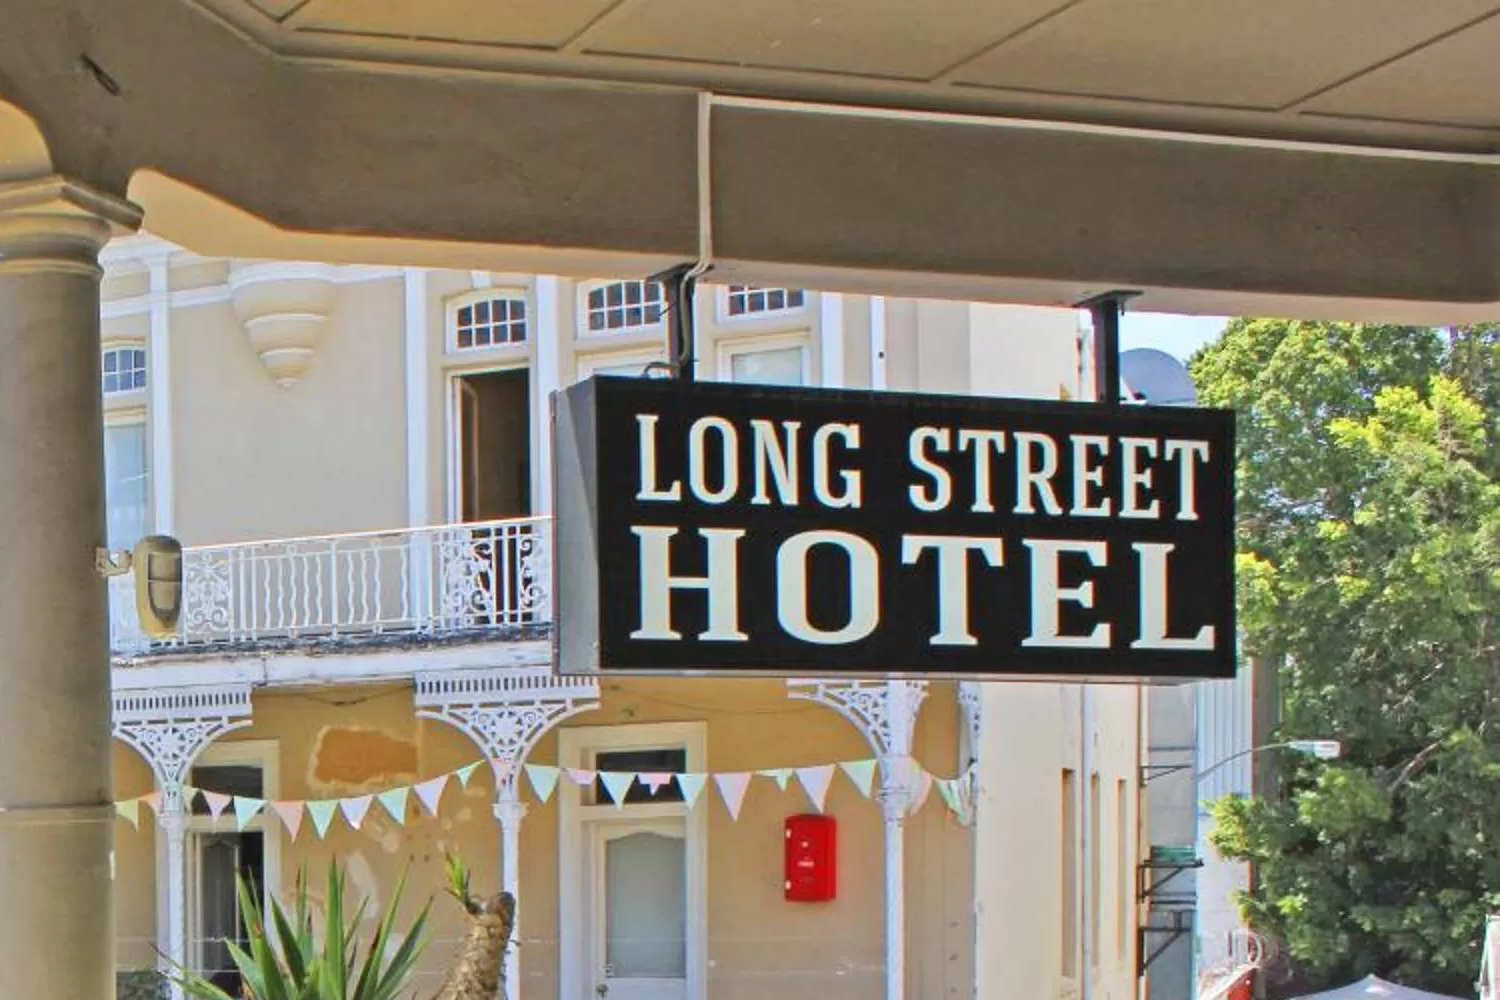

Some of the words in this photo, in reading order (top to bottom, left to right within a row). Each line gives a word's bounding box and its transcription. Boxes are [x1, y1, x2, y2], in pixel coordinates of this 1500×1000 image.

[635, 414, 862, 509] LONG
[908, 426, 1210, 521] STREET
[629, 525, 1215, 651] HOTEL
